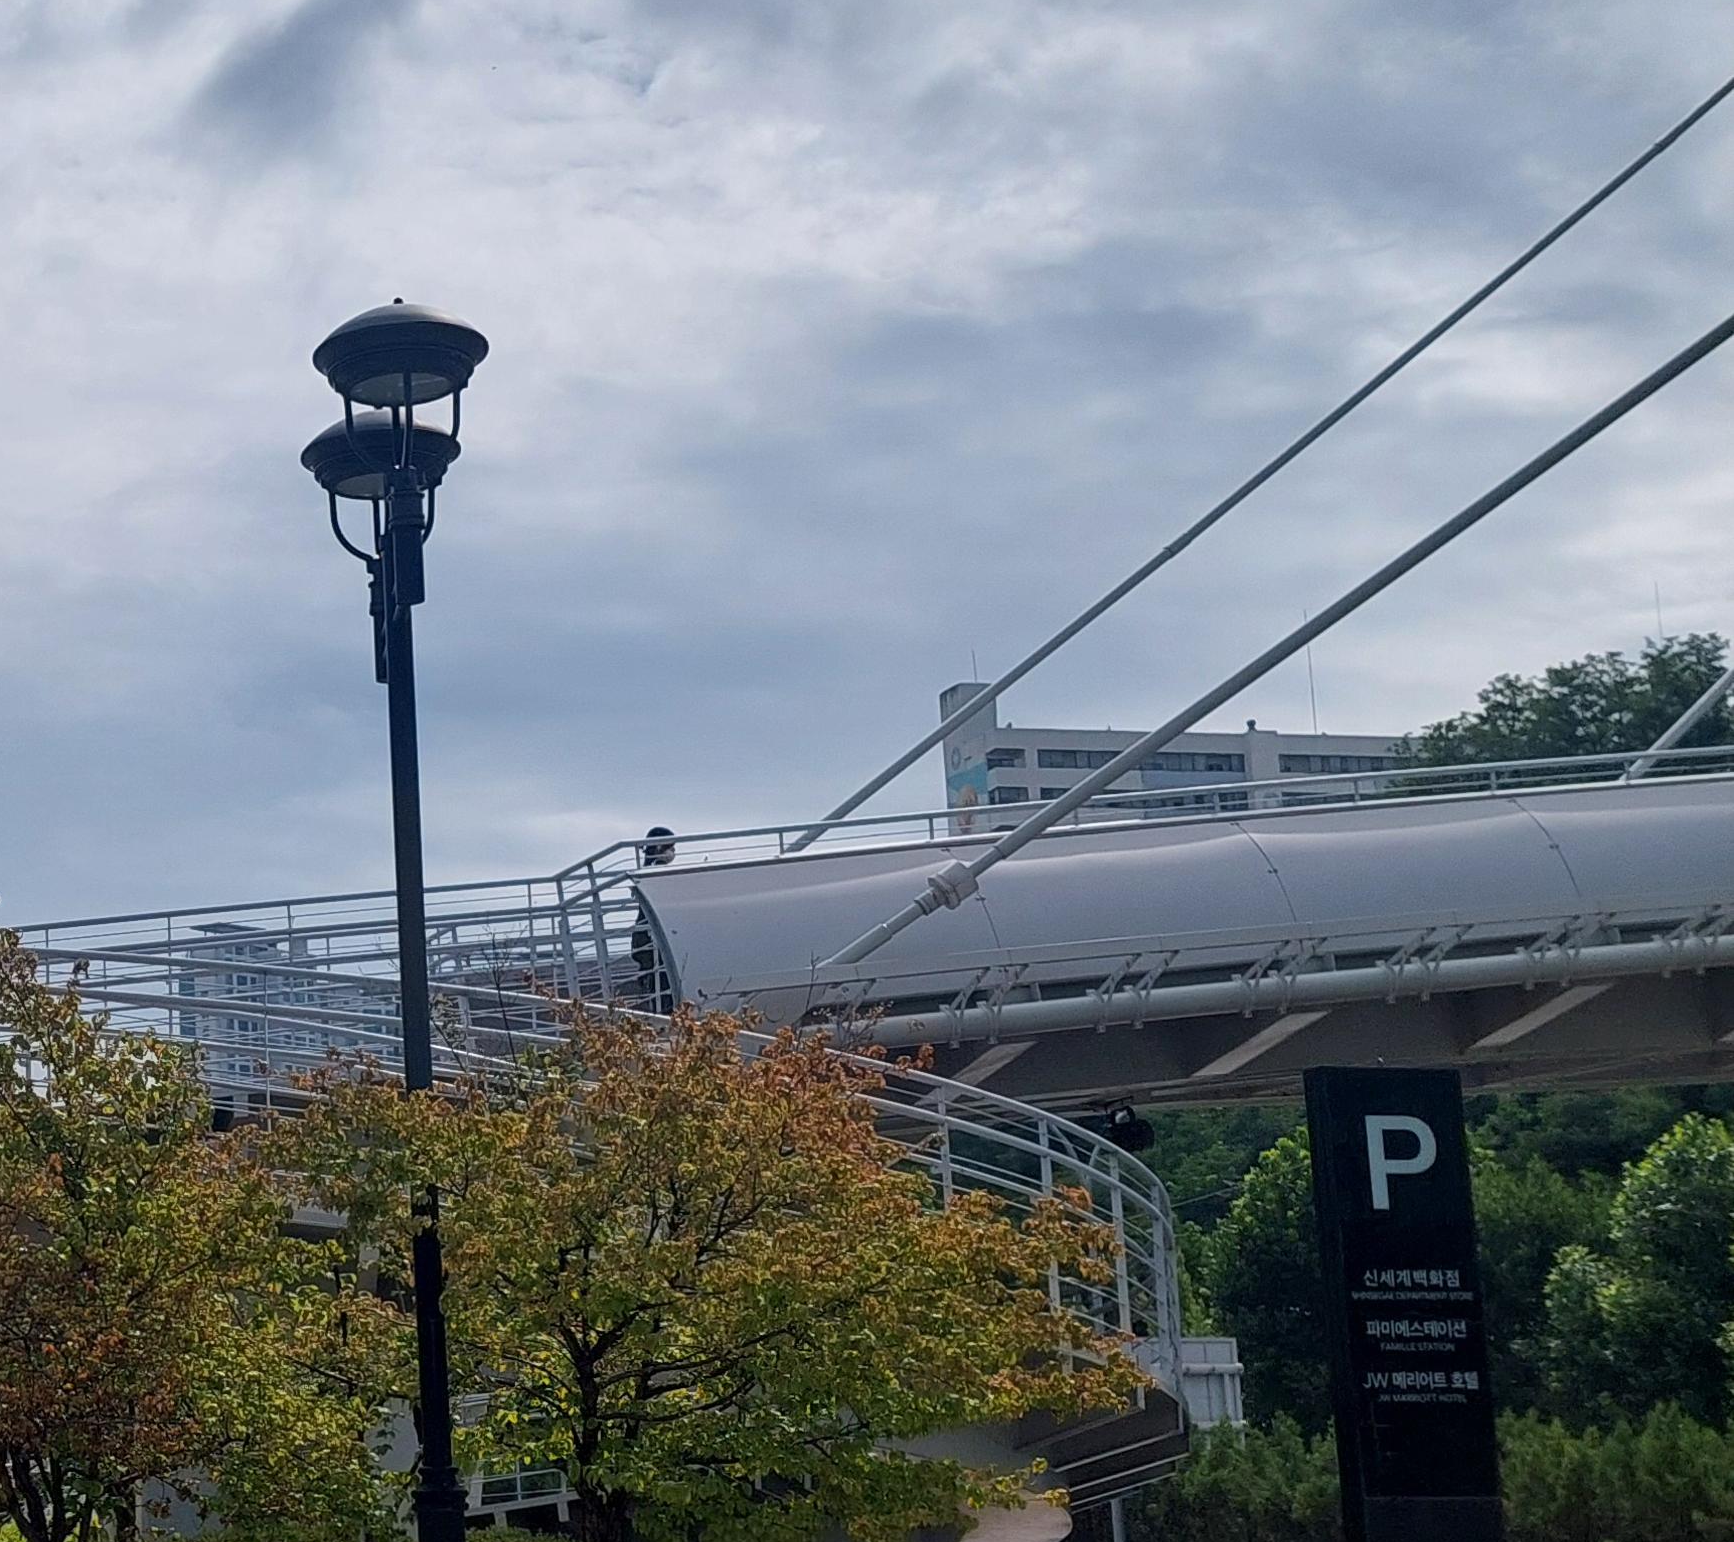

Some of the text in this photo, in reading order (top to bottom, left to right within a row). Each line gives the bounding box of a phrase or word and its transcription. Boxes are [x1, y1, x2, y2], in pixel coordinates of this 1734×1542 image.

[1364, 1114, 1437, 1210] P
[1363, 1269, 1460, 1289] 신세계백화점
[1365, 1319, 1467, 1339] 파미에스테이션
[1362, 1371, 1388, 1389] JW
[1392, 1370, 1449, 1390] 메리어트
